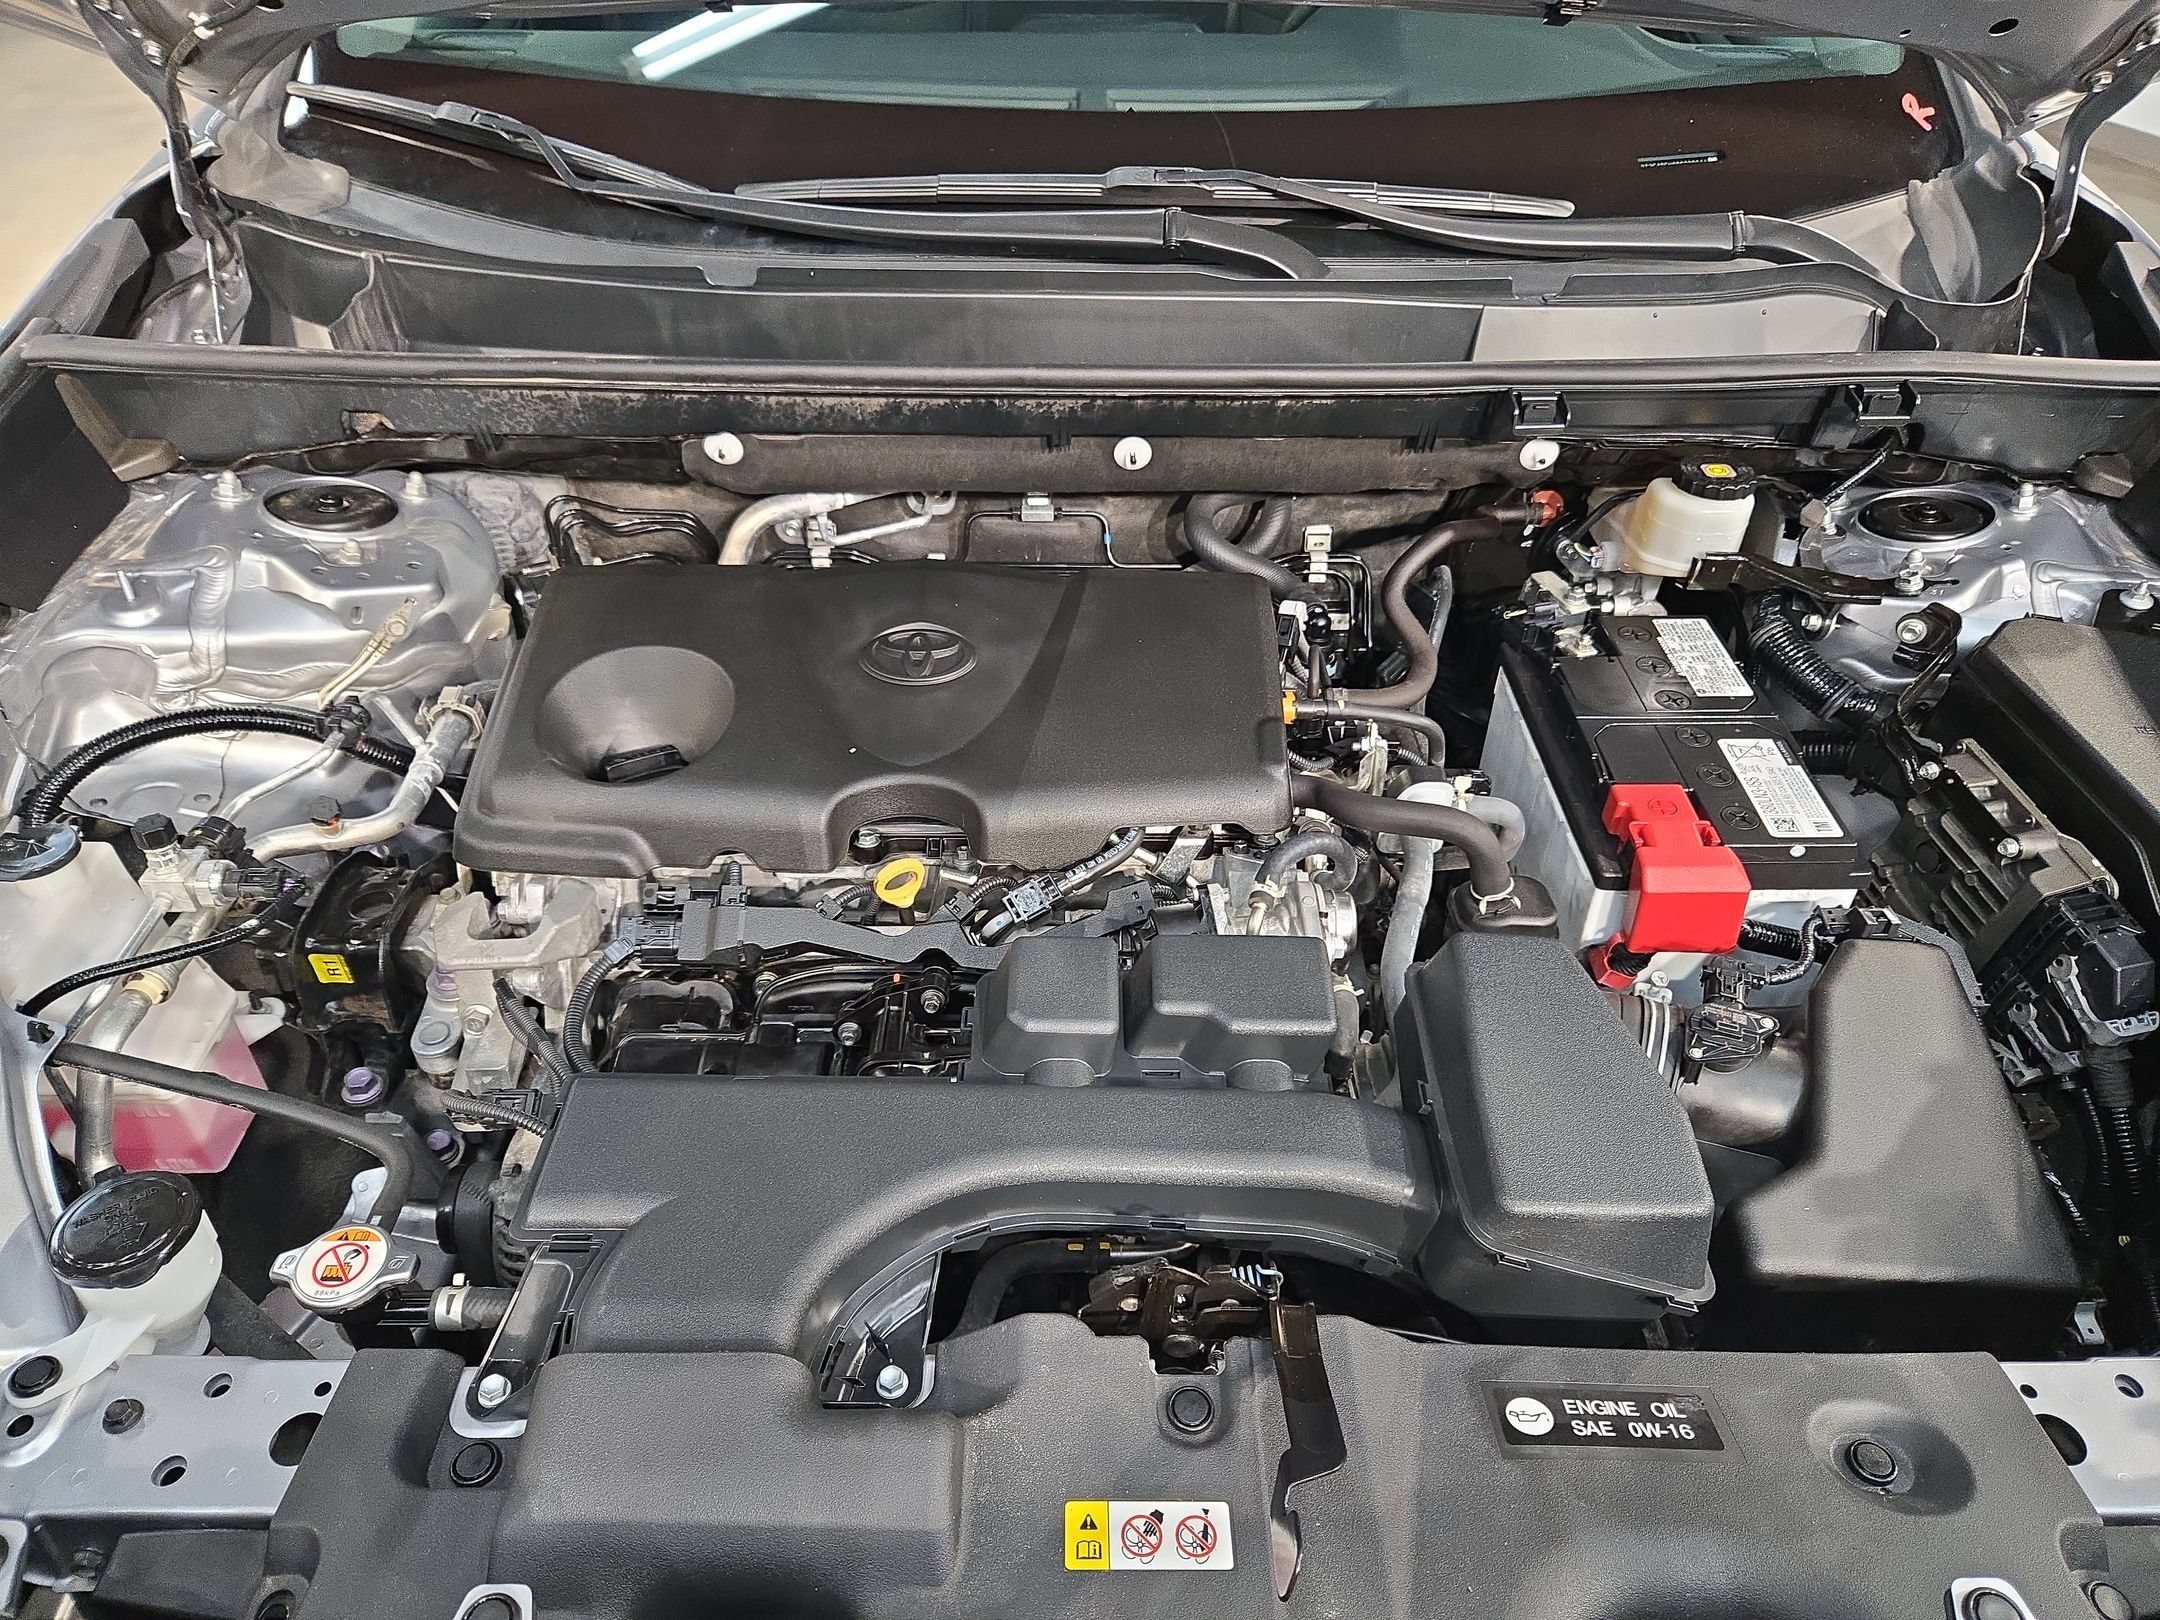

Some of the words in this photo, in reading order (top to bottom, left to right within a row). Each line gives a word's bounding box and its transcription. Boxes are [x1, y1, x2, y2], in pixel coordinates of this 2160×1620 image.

[322, 960, 343, 977] R1
[74, 1203, 121, 1229] WASHER
[127, 1187, 160, 1206] FLUID
[103, 1205, 134, 1222] ONLY
[1562, 1399, 1640, 1417] ENGINE
[1650, 1402, 1687, 1419] OIL
[1571, 1420, 1616, 1437] SAE
[1629, 1421, 1695, 1440] 0W-16
